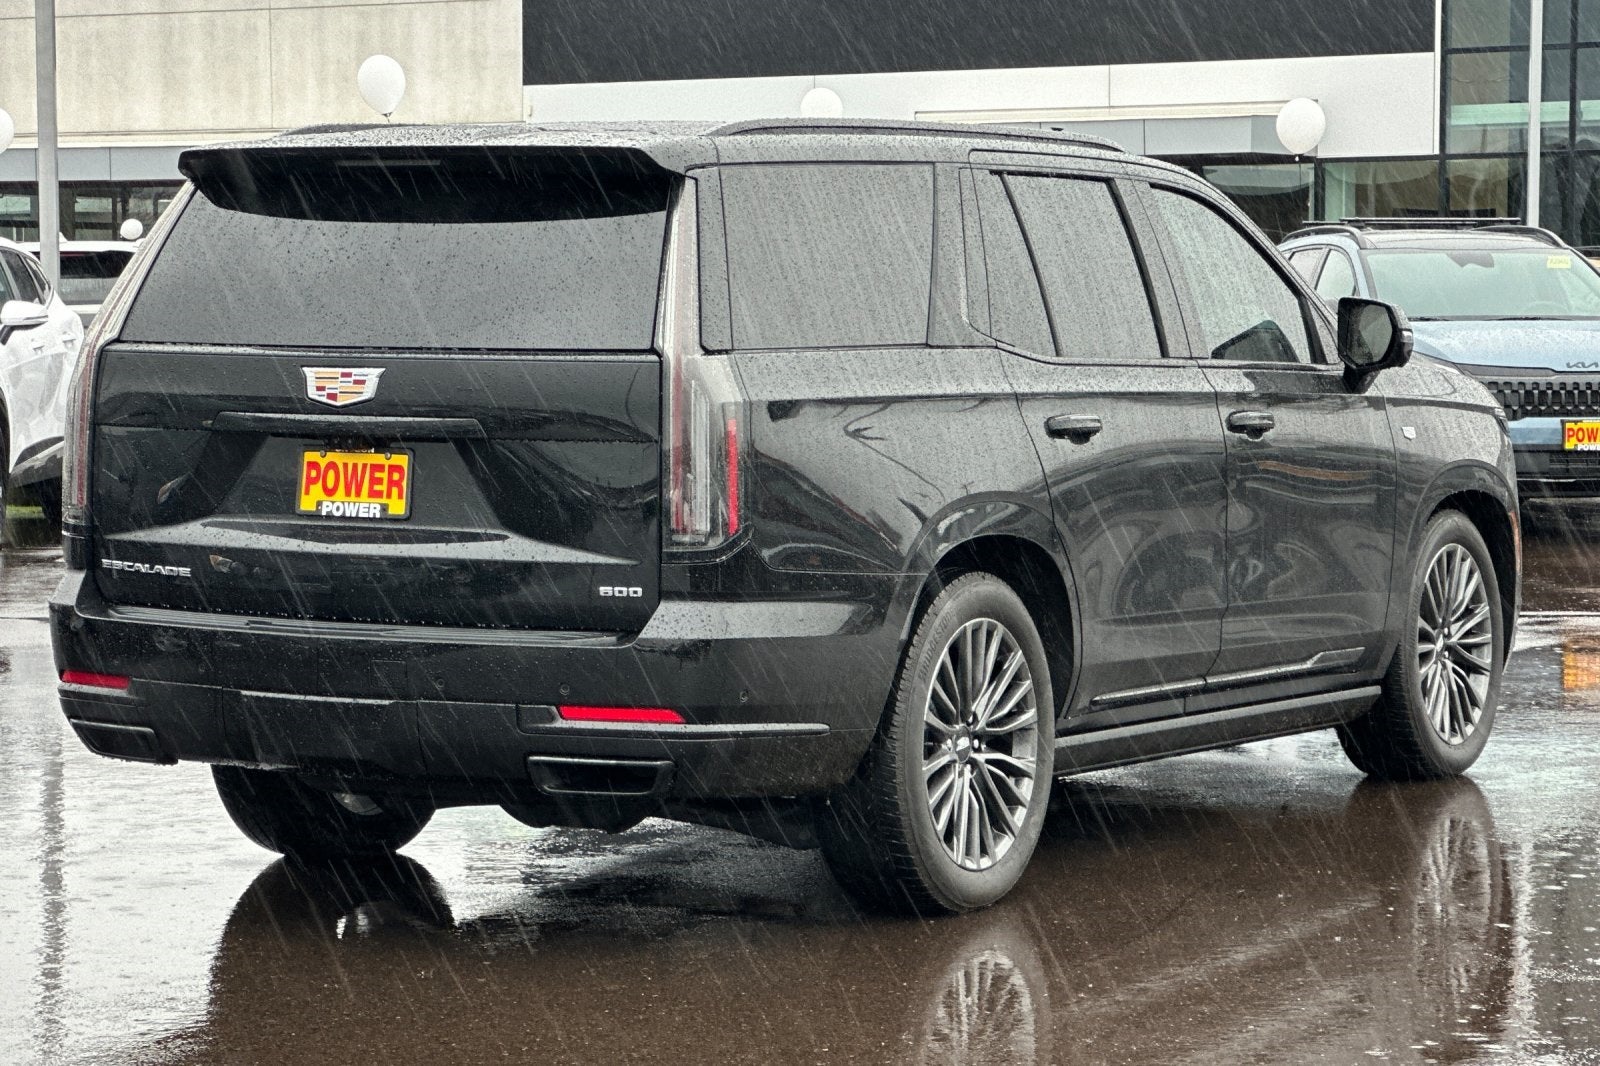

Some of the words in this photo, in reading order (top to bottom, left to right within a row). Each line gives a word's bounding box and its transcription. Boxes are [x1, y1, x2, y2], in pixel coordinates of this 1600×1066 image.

[1567, 427, 1600, 443] POW
[1578, 443, 1600, 451] POW
[304, 460, 405, 500] POWER
[321, 501, 381, 518] POWER
[101, 558, 191, 577] ESCALADE
[599, 586, 643, 597] 600
